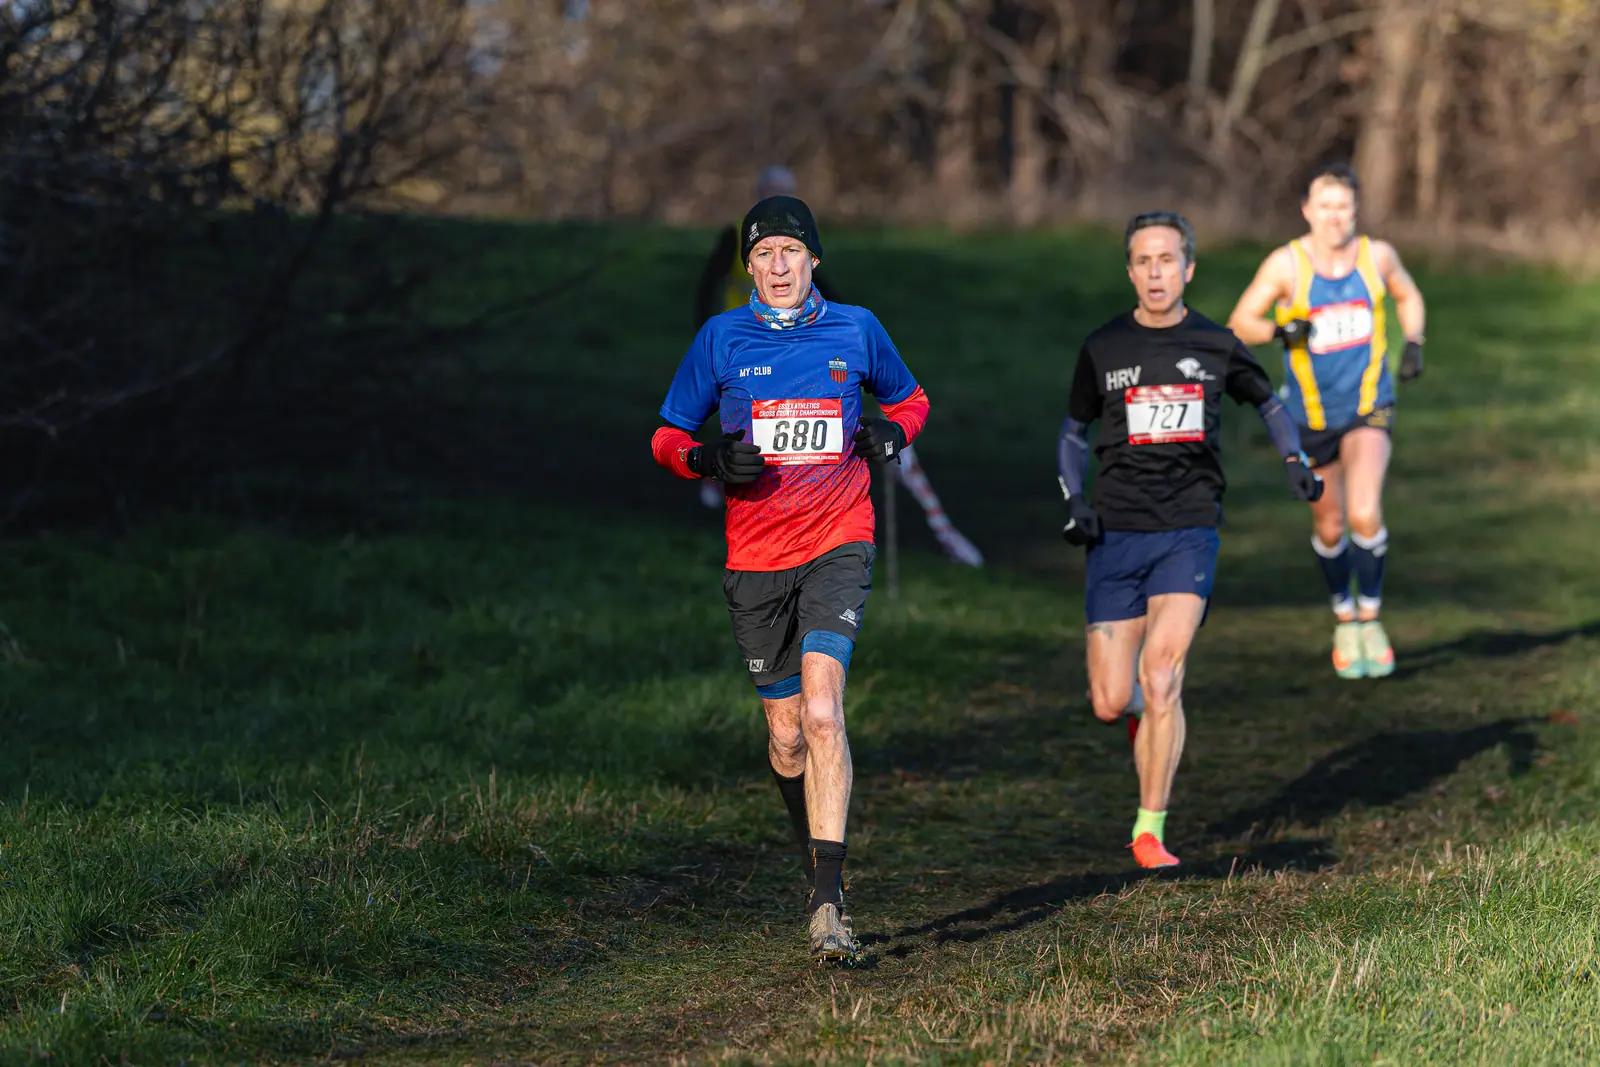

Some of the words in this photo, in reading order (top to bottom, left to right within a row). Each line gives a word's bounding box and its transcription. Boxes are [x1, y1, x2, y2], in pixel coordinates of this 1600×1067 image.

[1105, 365, 1142, 391] HRV
[776, 409, 799, 417] COUNTRY
[799, 409, 838, 417] CHAMPIONSHIPS
[1149, 403, 1189, 429] 727
[772, 419, 828, 452] 680
